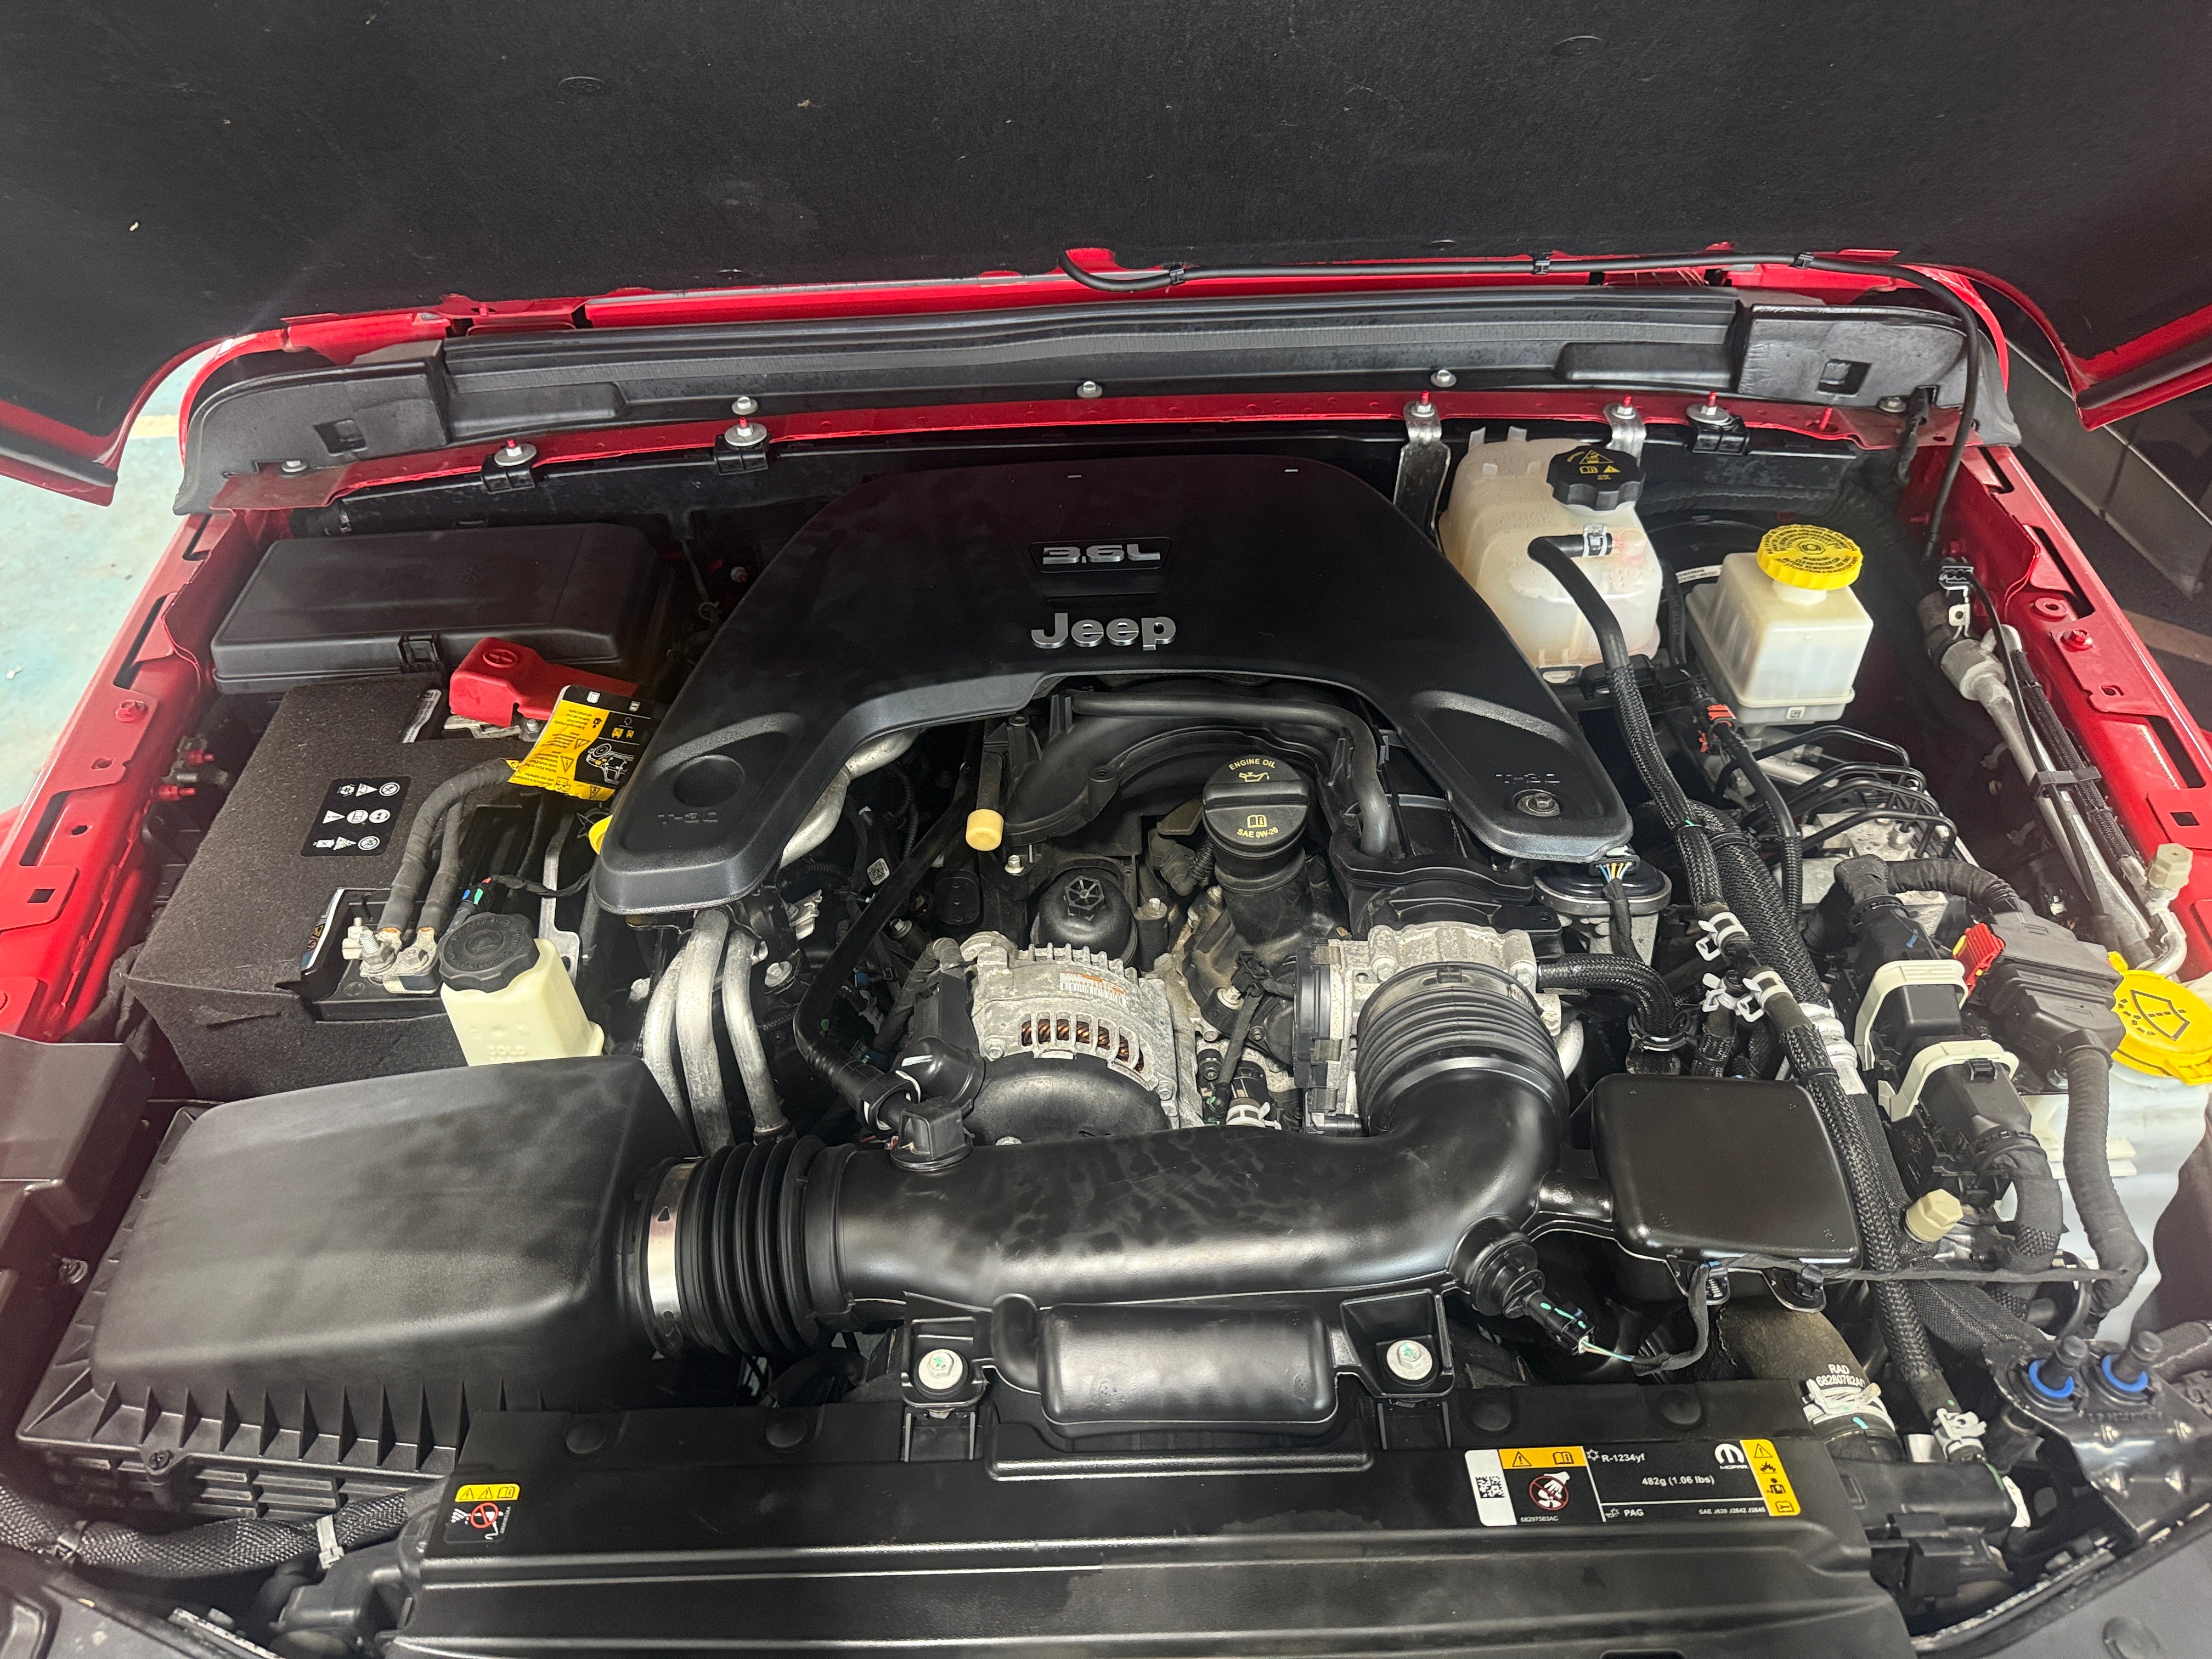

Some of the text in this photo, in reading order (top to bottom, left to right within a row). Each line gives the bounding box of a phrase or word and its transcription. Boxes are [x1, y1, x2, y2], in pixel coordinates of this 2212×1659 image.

[1043, 543, 1160, 565] 3.6L
[1031, 612, 1176, 651] Jeep
[1228, 758, 1276, 771] ENGINE OIL
[1237, 827, 1279, 838] SAE 0W-20
[1827, 1364, 1850, 1374] RAD
[1601, 1453, 1646, 1463] R-1234yf
[1641, 1475, 1716, 1487] 482g (1.06 lbs)
[1623, 1509, 1644, 1517] PAG
